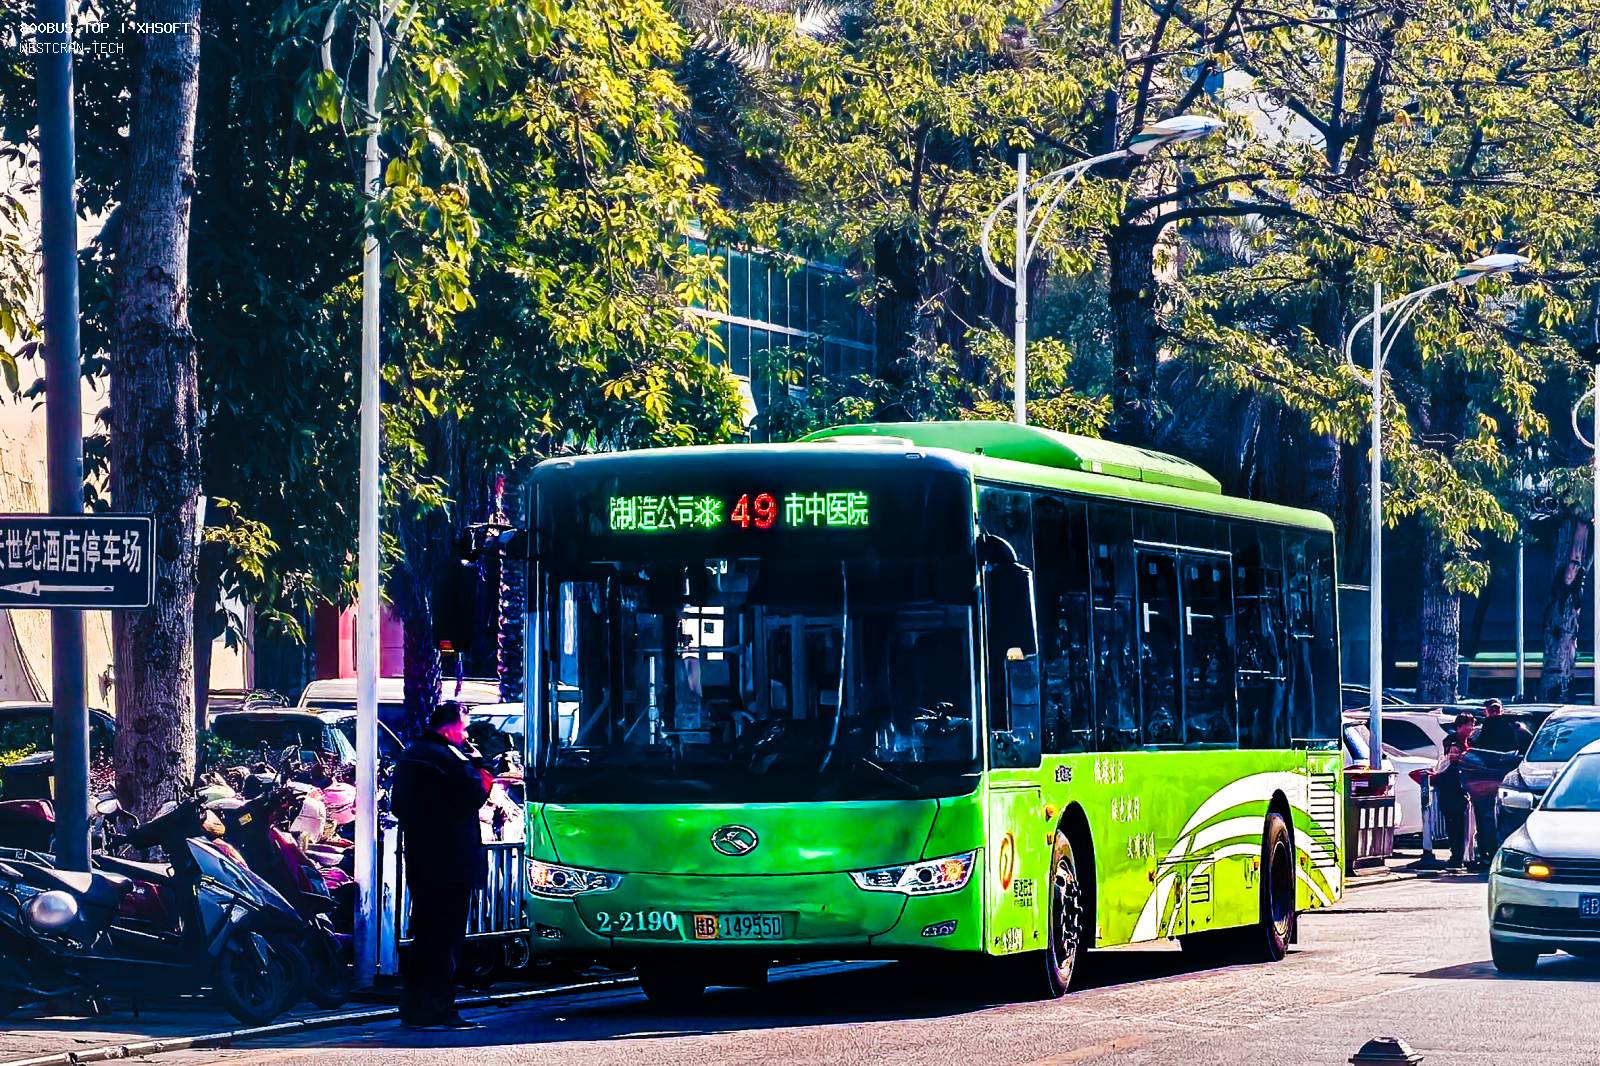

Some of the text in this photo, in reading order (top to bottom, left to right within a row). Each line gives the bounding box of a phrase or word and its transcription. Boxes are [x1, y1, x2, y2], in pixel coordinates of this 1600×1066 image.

[731, 493, 775, 527] 49
[784, 491, 869, 526] 市中医院
[0, 528, 142, 573] 世纪酒店停车场
[597, 911, 677, 932] 2-2190
